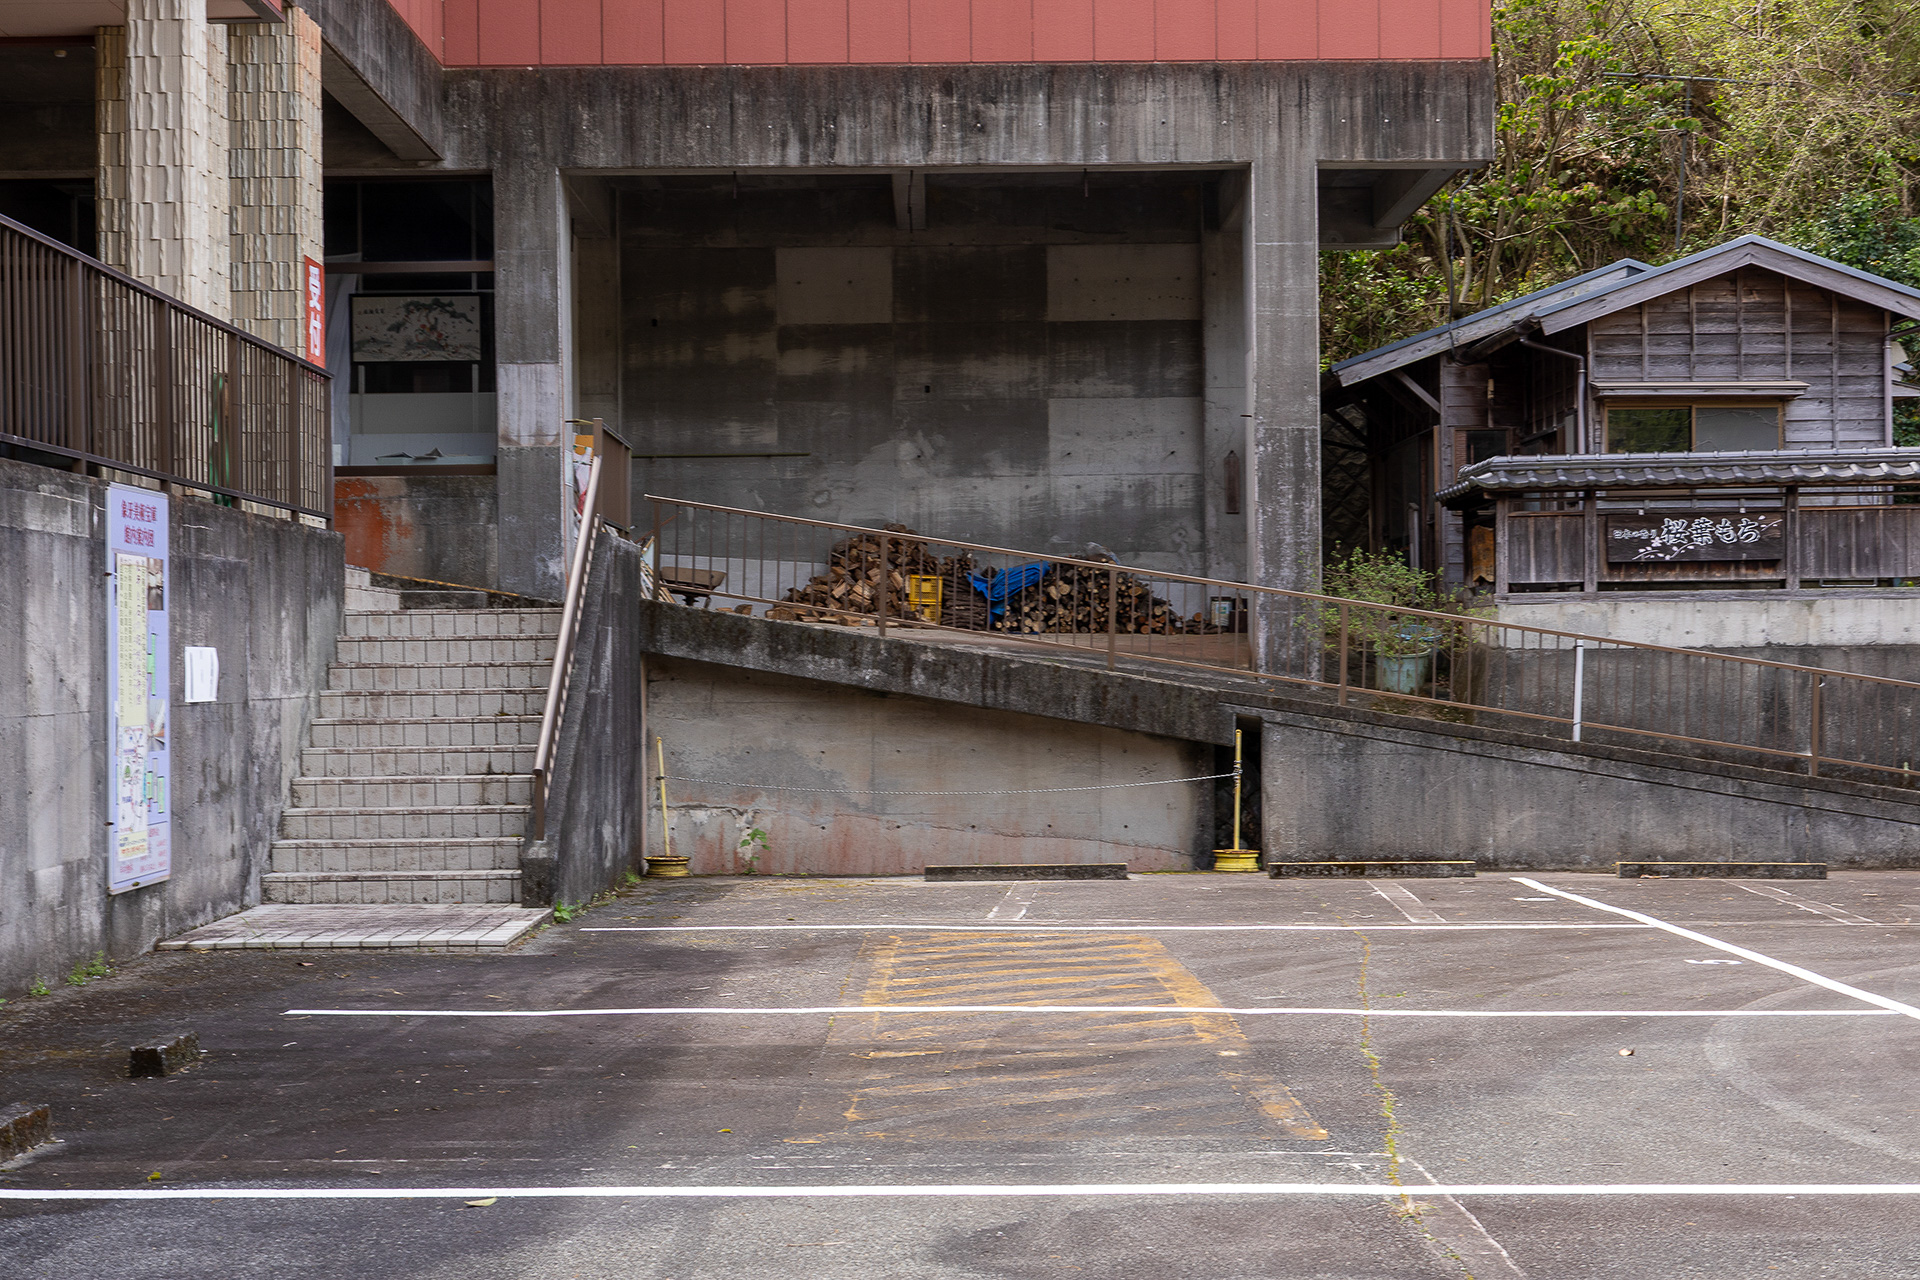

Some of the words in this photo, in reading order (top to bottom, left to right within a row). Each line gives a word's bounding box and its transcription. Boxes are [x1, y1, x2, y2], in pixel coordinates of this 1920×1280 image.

[308, 265, 322, 357] 受付
[1660, 517, 1761, 546] 桜葉もち
